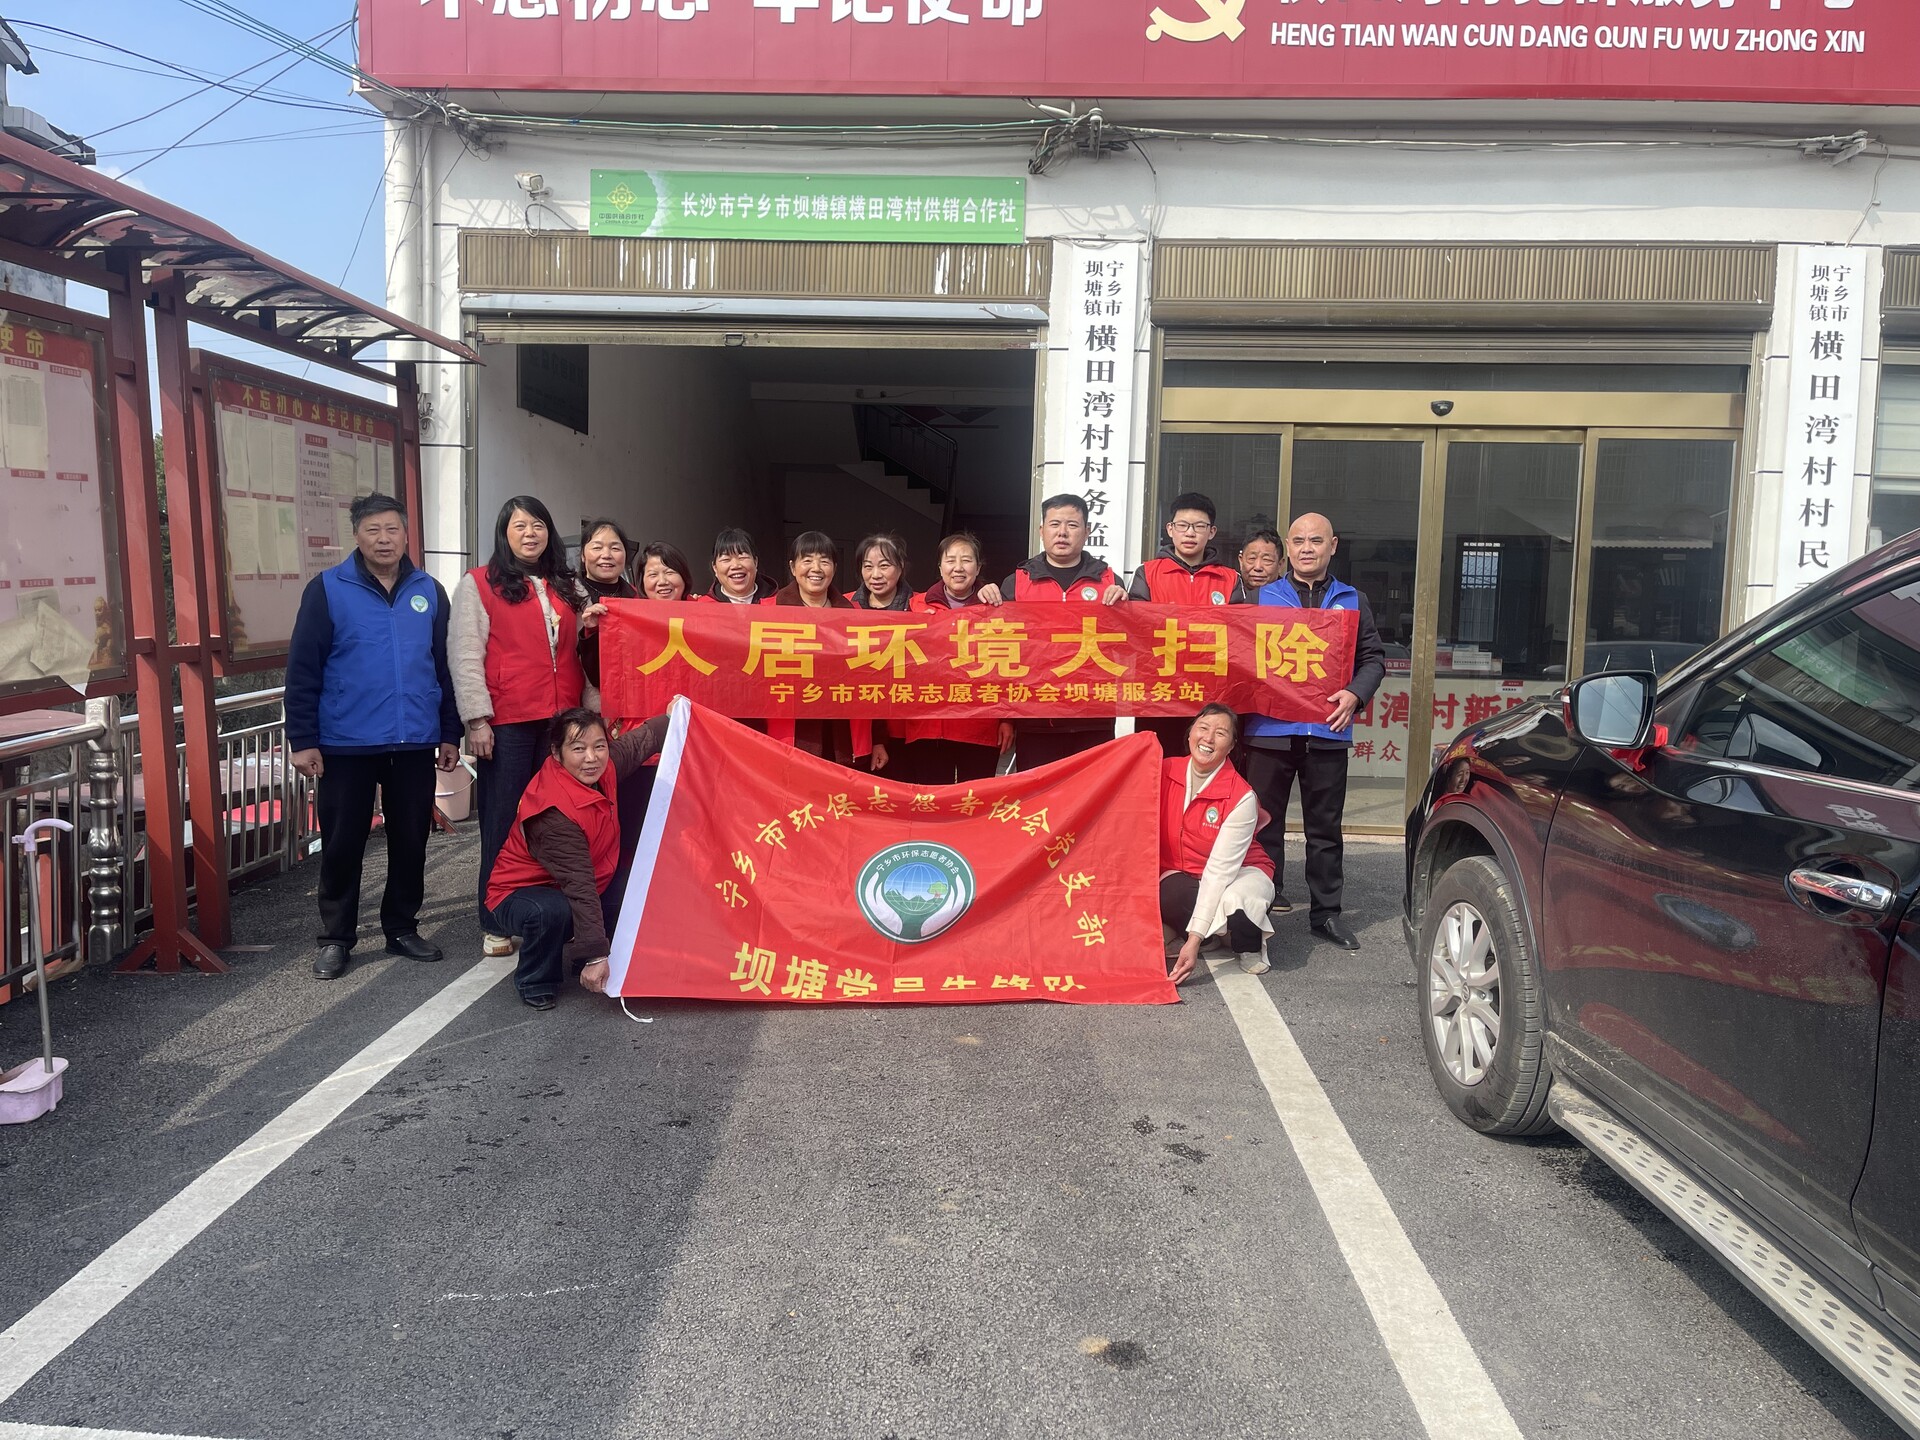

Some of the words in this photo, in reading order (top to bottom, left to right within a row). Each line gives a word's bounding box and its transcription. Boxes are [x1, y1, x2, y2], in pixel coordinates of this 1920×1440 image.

[1271, 22, 1335, 47] HENG
[1341, 24, 1395, 47] TIAN
[1401, 24, 1457, 47] WAN
[1463, 24, 1514, 47] CUN
[1519, 25, 1588, 48] DANG
[1594, 26, 1647, 49] QUN
[1653, 27, 1683, 49] FU
[1689, 27, 1729, 50] WU
[1734, 28, 1818, 51] ZHONG
[1824, 29, 1865, 52] XIN
[681, 191, 1016, 224] 长沙市宁乡市坝塘镇横田湾村供销合作社
[1083, 260, 1104, 317] 坝塘镇
[1106, 260, 1125, 317] 宁乡市
[1809, 264, 1830, 323] 坝塘镇
[1830, 264, 1851, 323] 宁乡市
[242, 384, 303, 418] 不忘初心
[1079, 324, 1119, 560] 横田湾村村务监
[1795, 330, 1845, 591] 横田湾村村民
[635, 616, 1330, 682] 人居环境大扫除
[770, 682, 1204, 704] 宁乡市环保志愿者协会坝塘服务站
[1352, 739, 1402, 763] 群众
[876, 849, 959, 875] 宁乡市环保志愿者协会
